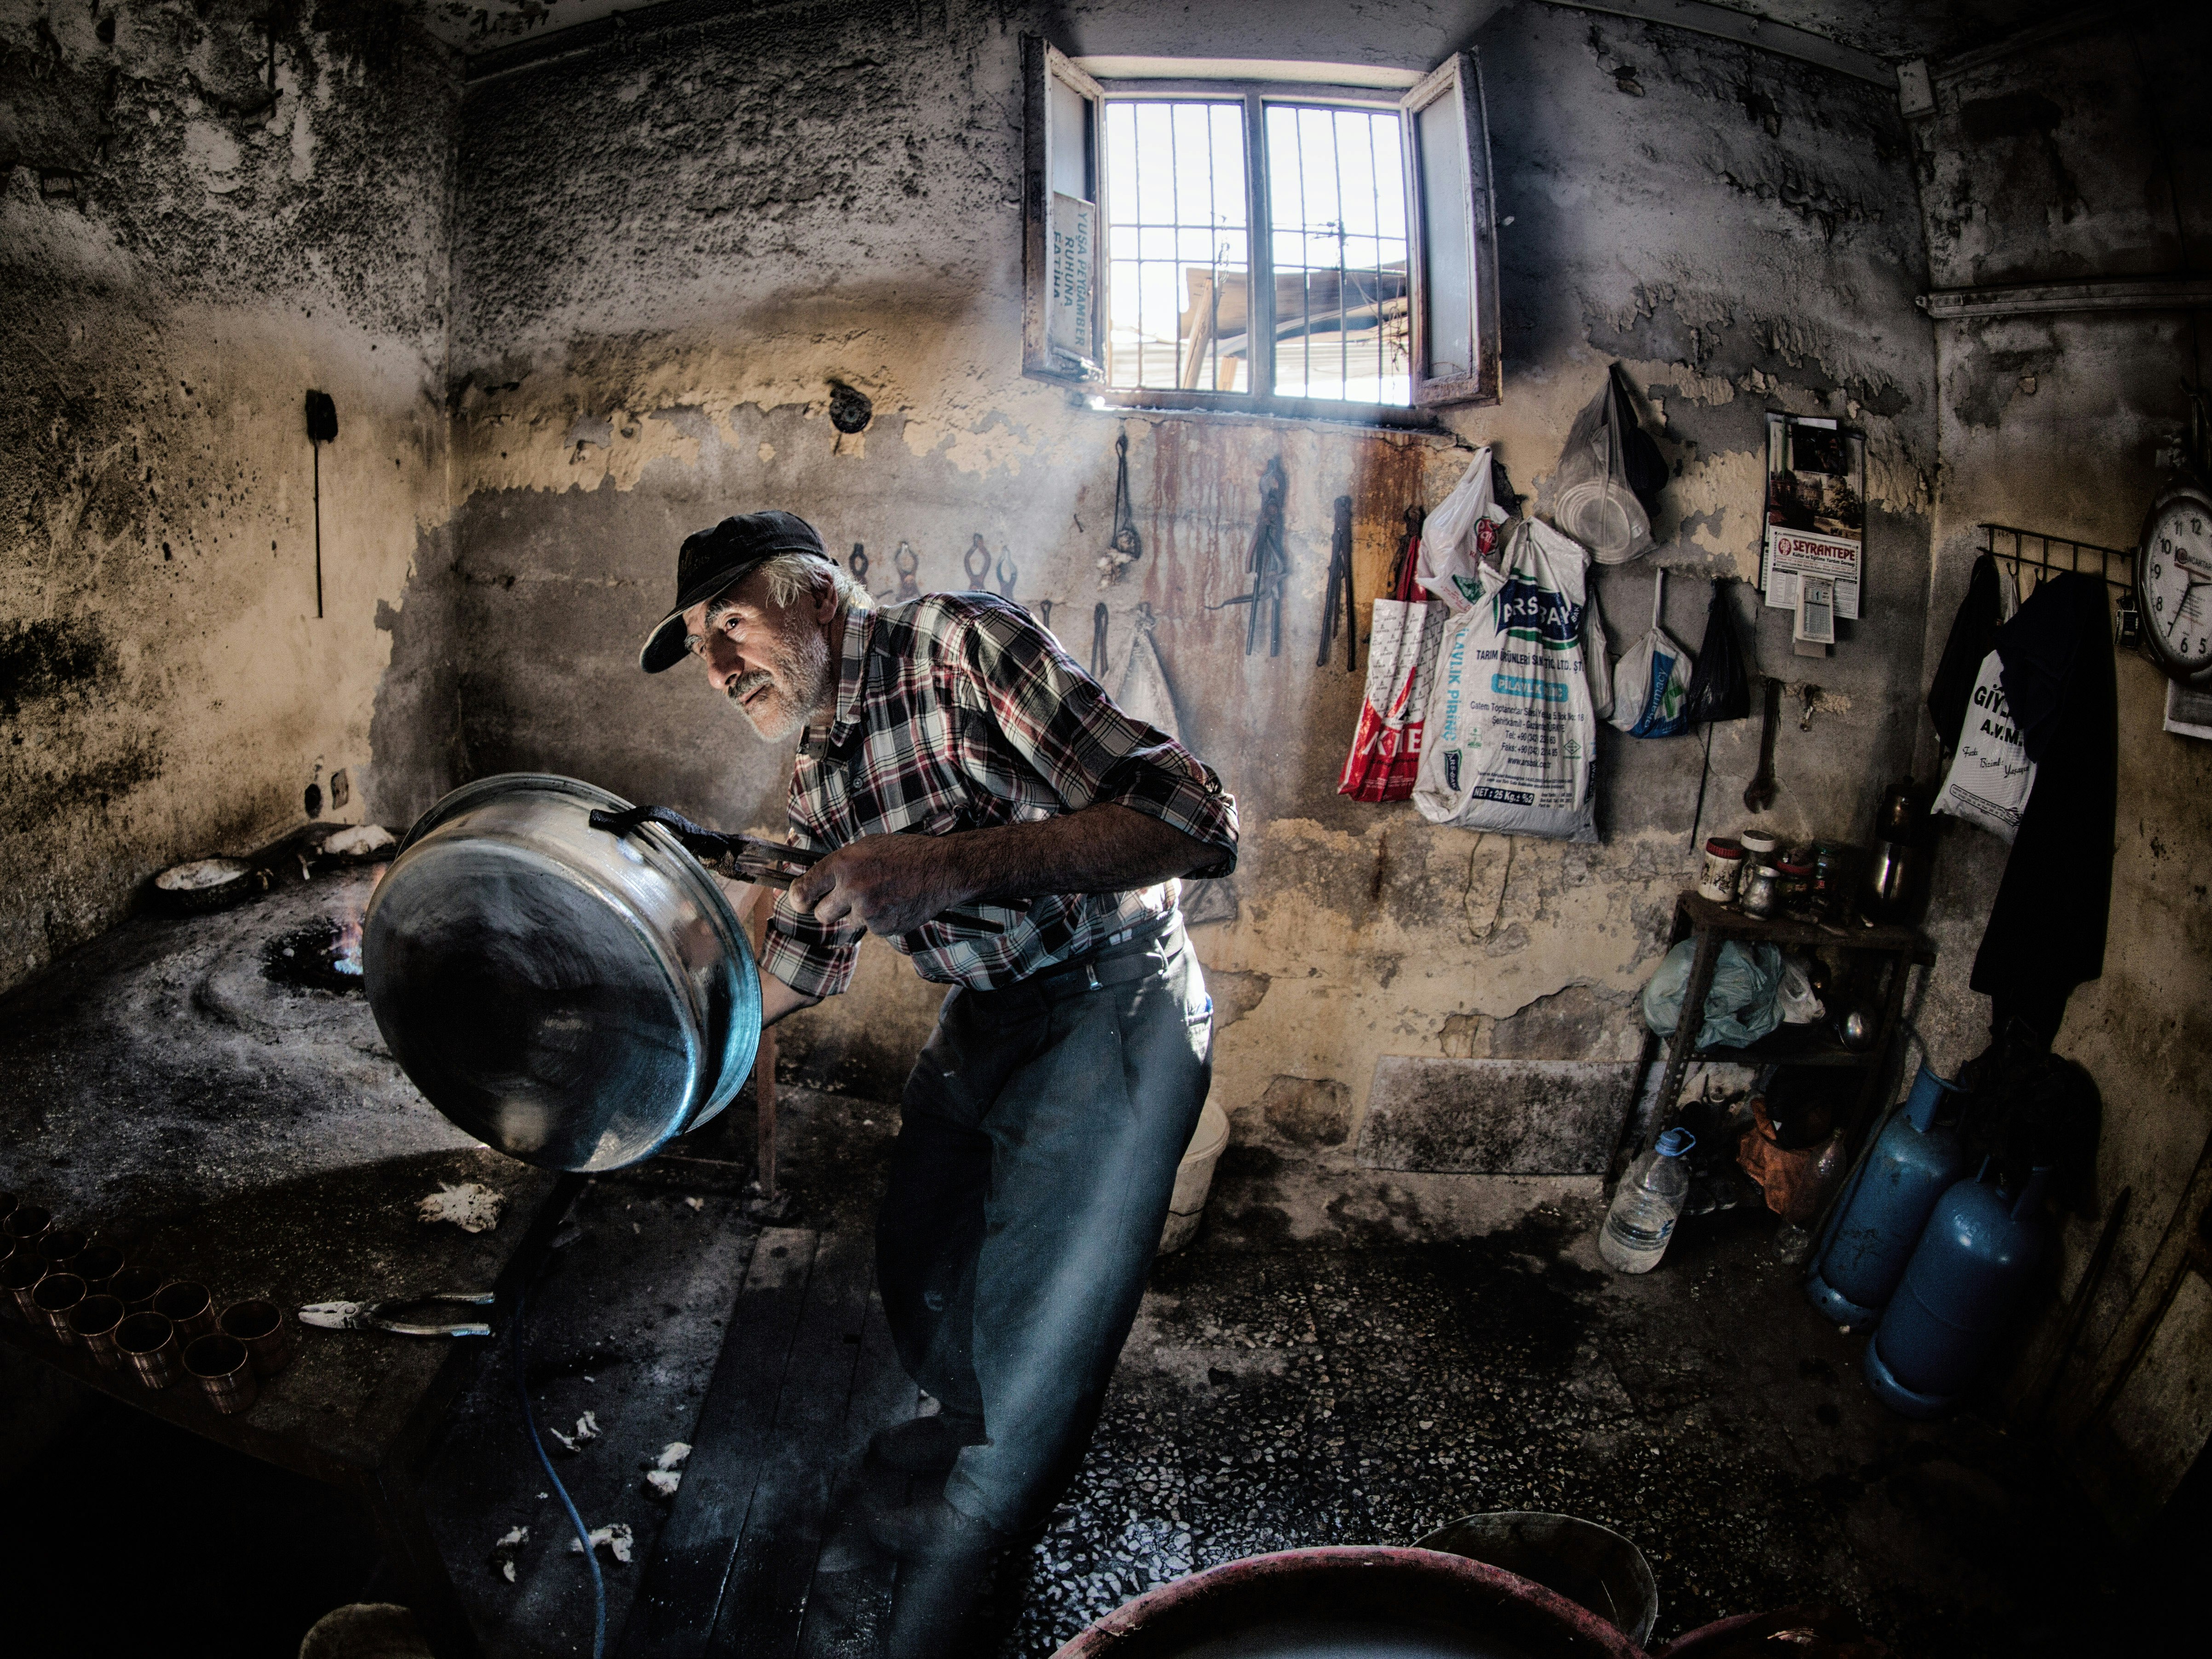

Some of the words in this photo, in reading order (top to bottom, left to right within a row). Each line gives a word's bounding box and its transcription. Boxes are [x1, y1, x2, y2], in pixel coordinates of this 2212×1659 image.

[1075, 212, 1088, 254] YUŞA
[1054, 230, 1063, 298] FATİHA
[1064, 236, 1074, 306] RUHUNA
[1075, 258, 1087, 346] PEYGAMBER
[2174, 520, 2183, 536] 11
[2191, 518, 2201, 535] 12
[1793, 539, 1855, 561] SEYRANTEPE
[2160, 538, 2171, 554] 10
[2154, 564, 2161, 579] 9
[2156, 596, 2163, 611] 8
[2181, 638, 2188, 653] 6
[2199, 638, 2207, 654] 5
[1477, 650, 1498, 660] TARIM
[1474, 787, 1489, 797] NET
[1493, 790, 1503, 800] 25
